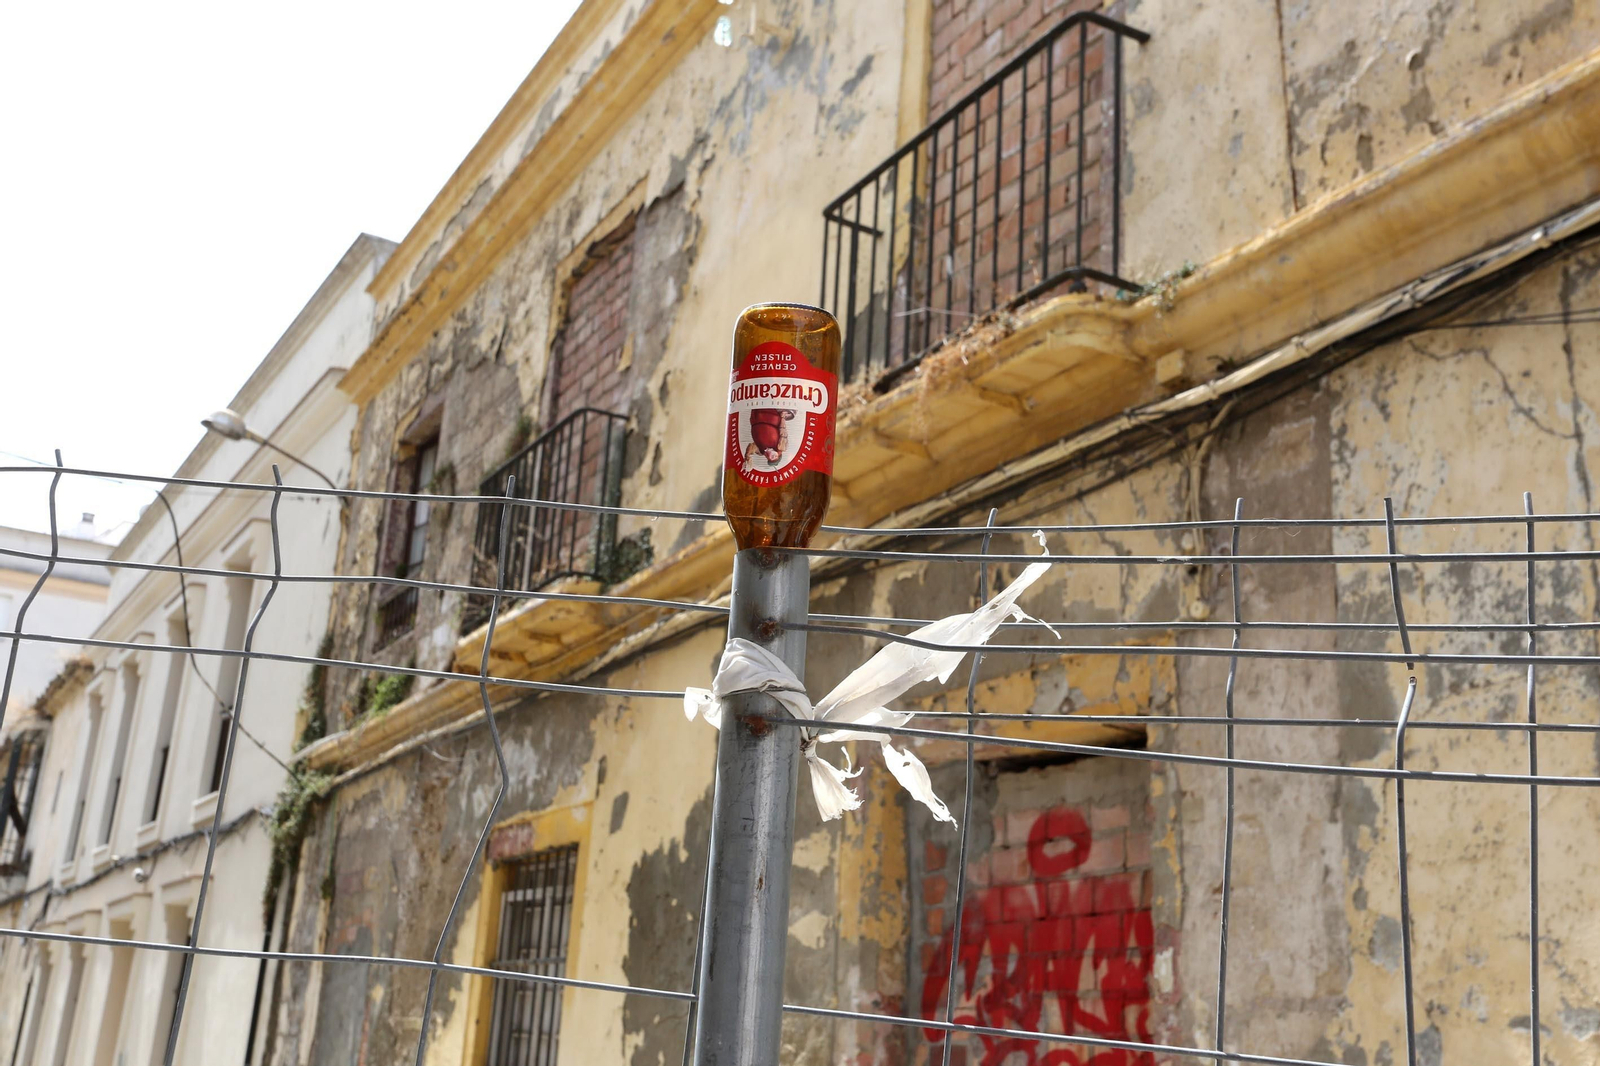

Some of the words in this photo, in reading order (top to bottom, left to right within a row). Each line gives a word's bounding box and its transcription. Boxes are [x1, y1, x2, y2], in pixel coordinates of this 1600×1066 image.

[754, 353, 792, 361] PILSEN
[750, 363, 797, 371] CERVEZA
[731, 383, 822, 408] Cruzcampo
[804, 431, 815, 450] CRUZ
[773, 465, 799, 483] CAMPO
